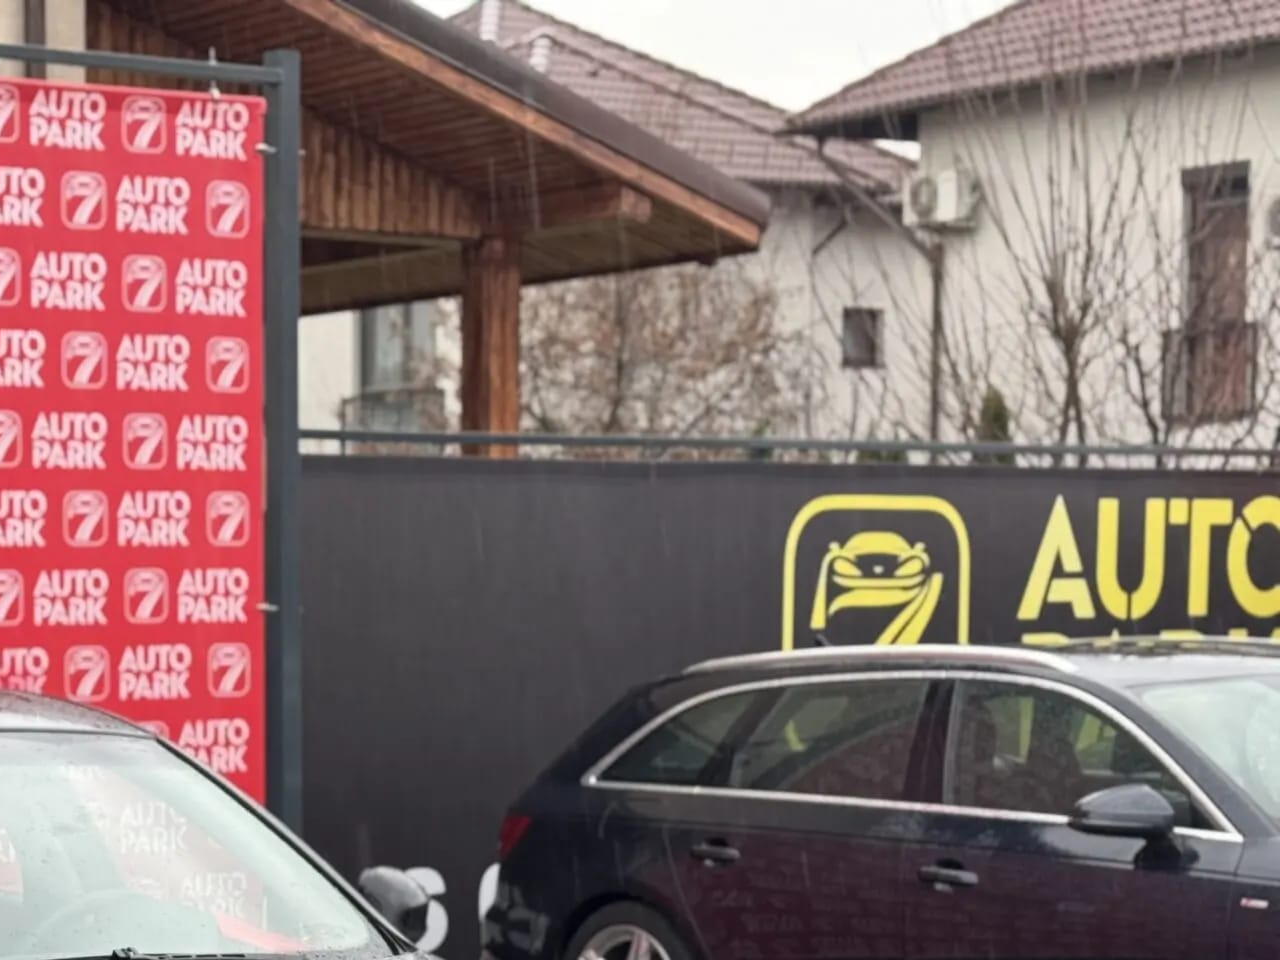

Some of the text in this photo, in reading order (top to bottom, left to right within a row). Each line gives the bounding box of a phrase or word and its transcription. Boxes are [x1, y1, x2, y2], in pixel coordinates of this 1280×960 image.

[30, 91, 105, 120] AUTO
[176, 102, 248, 131] AUTO
[30, 116, 104, 150] PARK
[176, 127, 246, 160] PARK
[116, 176, 190, 205] AUTO
[116, 202, 187, 234] PARK
[31, 252, 106, 281] AUTO
[176, 259, 247, 288] AUTO
[31, 279, 104, 310] PARK
[176, 285, 245, 316] PARK
[117, 335, 189, 363] AUTO
[117, 361, 187, 390] PARK
[32, 413, 107, 441] AUTO
[177, 416, 248, 443] AUTO
[33, 439, 105, 468] PARK
[177, 441, 245, 470] PARK
[118, 491, 190, 519] AUTO
[118, 517, 188, 546] PARK
[34, 569, 108, 598] AUTO
[178, 568, 248, 595] AUTO
[34, 596, 106, 625] PARK
[178, 594, 246, 622] PARK
[119, 644, 191, 673] AUTO
[120, 671, 189, 700] PARK
[179, 718, 250, 747] AUTO
[186, 744, 247, 779] ARK
